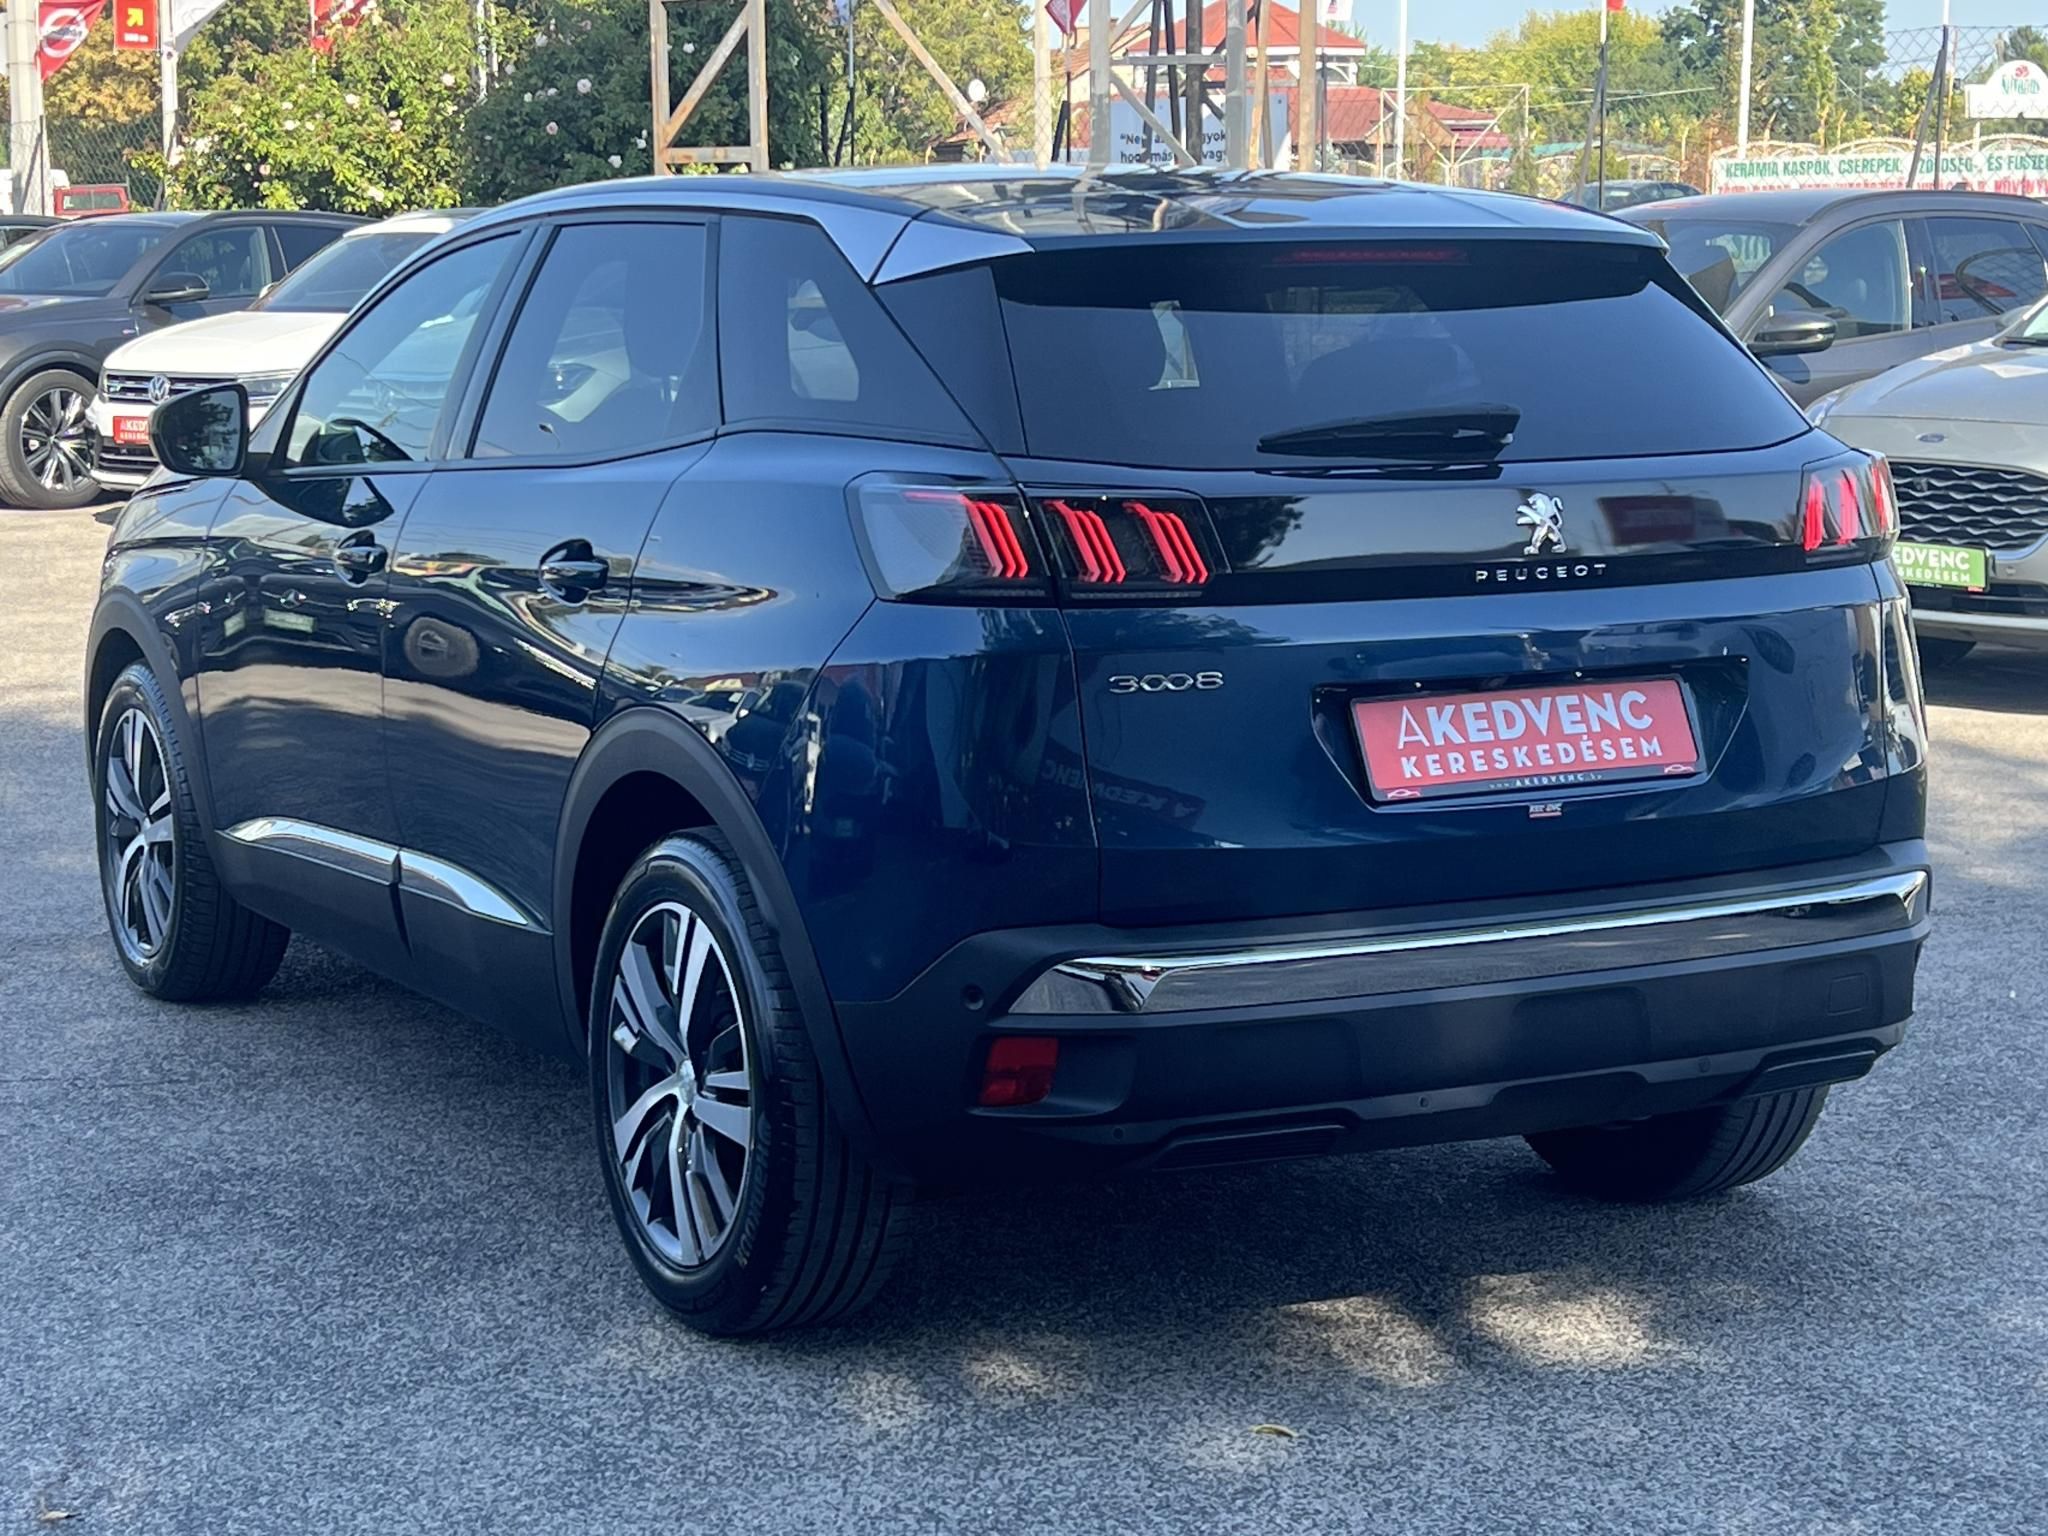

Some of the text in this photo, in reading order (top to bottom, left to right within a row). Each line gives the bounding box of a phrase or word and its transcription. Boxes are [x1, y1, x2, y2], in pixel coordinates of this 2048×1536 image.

[1893, 546, 1970, 570] EDVENC
[1475, 563, 1607, 582] PEUGEOT
[1108, 671, 1224, 693] 3008
[1400, 734, 1663, 779] KERESKEDÉSEM
